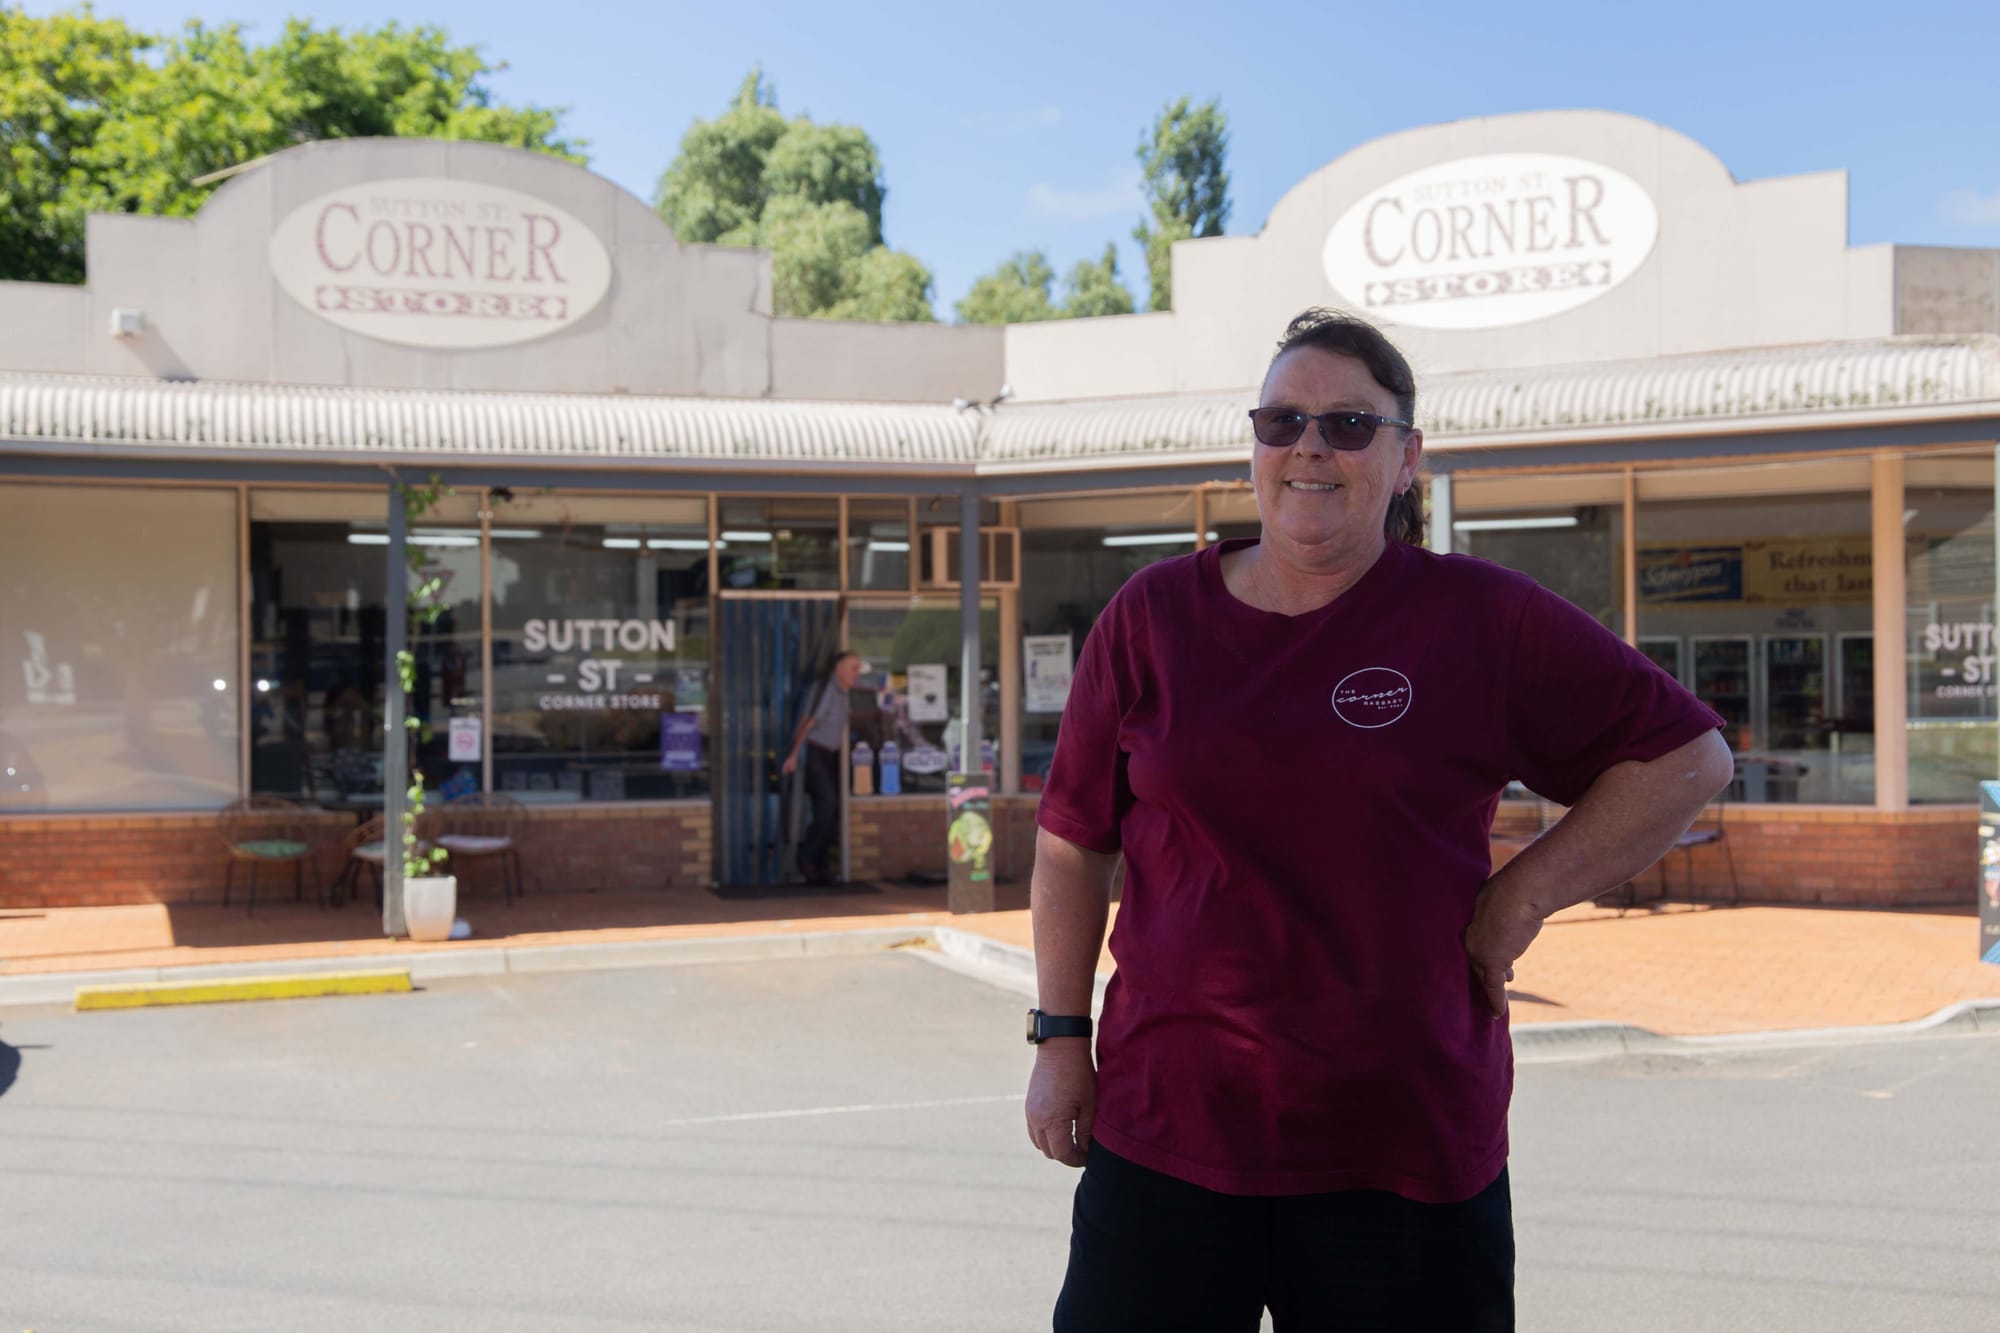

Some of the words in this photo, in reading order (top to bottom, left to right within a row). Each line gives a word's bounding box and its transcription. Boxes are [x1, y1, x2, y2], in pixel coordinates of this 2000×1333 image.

[1415, 177, 1506, 201] SUTTON
[368, 196, 467, 219] SUTTON
[1364, 175, 1611, 268] CORNER
[315, 201, 568, 284] CORNER
[1394, 263, 1581, 302] STORE
[346, 288, 539, 318] STORE
[523, 619, 675, 651] SUTTON
[1925, 622, 1997, 651] SUTT
[578, 659, 622, 692] ST
[1963, 656, 1994, 683] ST
[539, 695, 605, 710] CORNER
[611, 694, 661, 709] STORE
